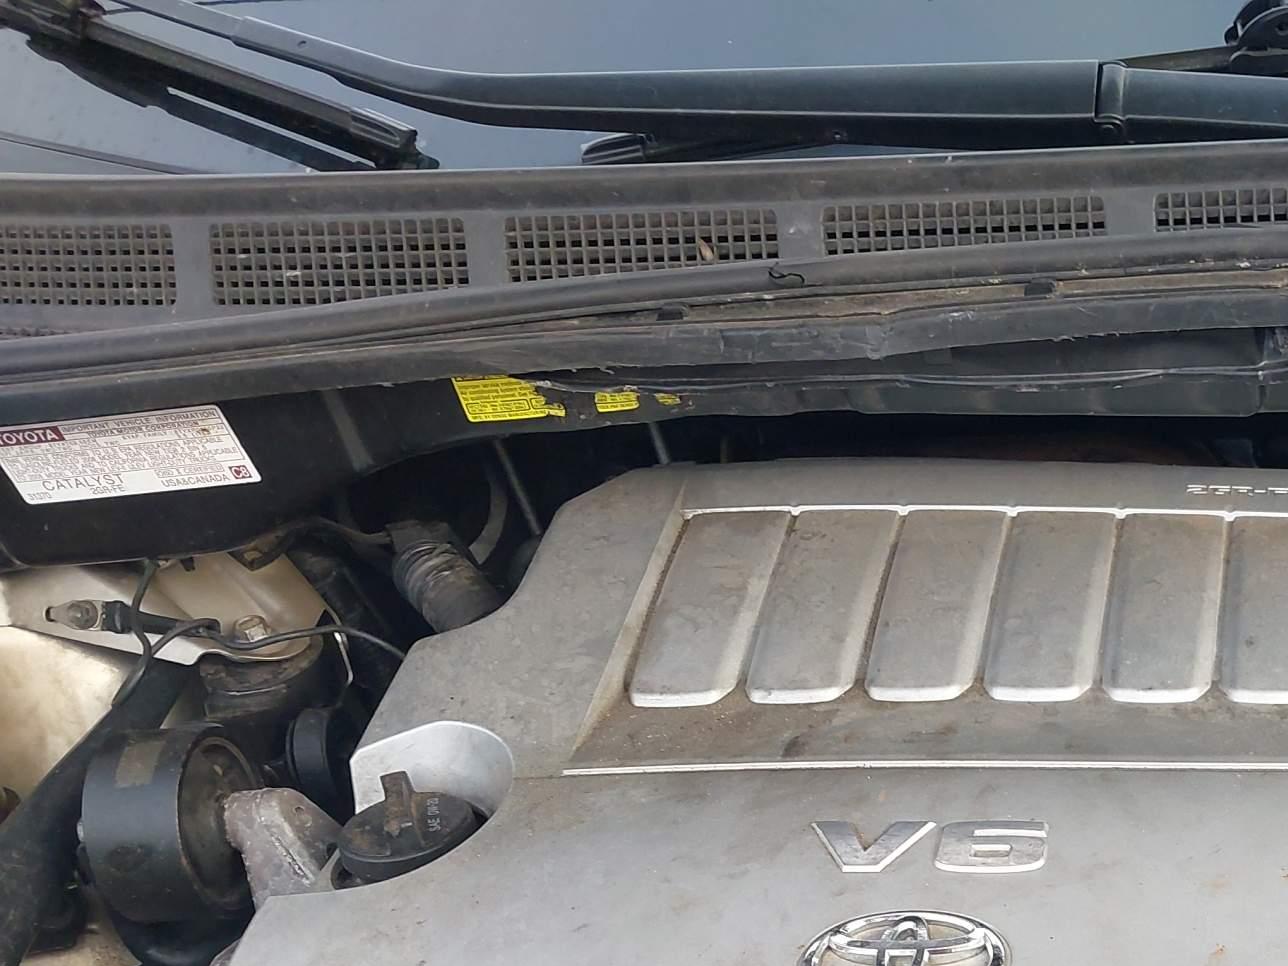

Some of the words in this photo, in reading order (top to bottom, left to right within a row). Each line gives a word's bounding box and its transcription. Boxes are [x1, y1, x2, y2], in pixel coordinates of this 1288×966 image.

[60, 422, 110, 432] IMPORTANT
[112, 417, 152, 426] VEHICLE
[154, 410, 216, 422] INFORMATION
[230, 465, 250, 478] C8
[42, 473, 124, 491] CATALYST
[161, 473, 230, 488] USA&CANADA
[90, 484, 126, 495] 2GR-FE
[428, 816, 440, 832] SAE
[811, 821, 1048, 873] V6
